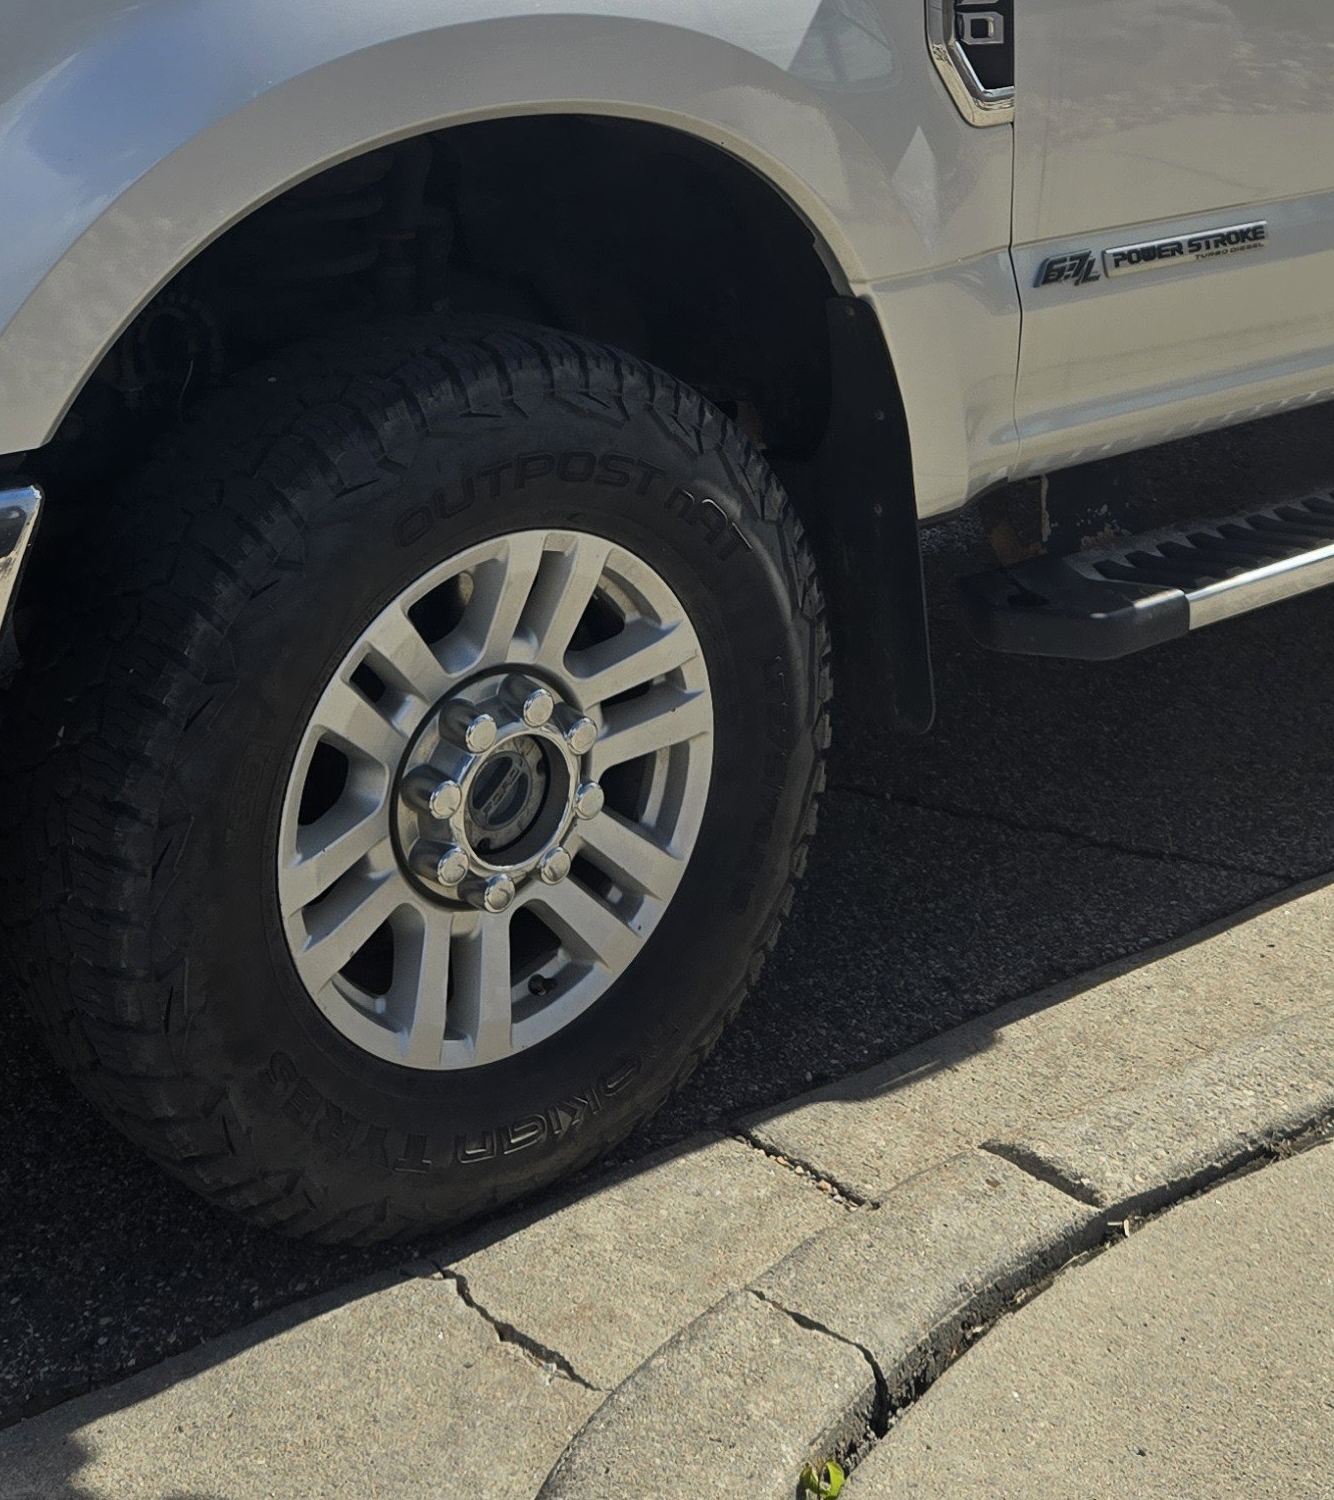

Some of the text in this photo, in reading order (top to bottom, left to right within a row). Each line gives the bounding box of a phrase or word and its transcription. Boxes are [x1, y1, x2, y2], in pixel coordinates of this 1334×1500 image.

[1113, 241, 1184, 268] POWER
[1187, 225, 1265, 253] STROKE
[1194, 242, 1265, 260] TURBO DIESEL
[392, 449, 667, 548] OUTPOST
[258, 1051, 434, 1176] TYRES
